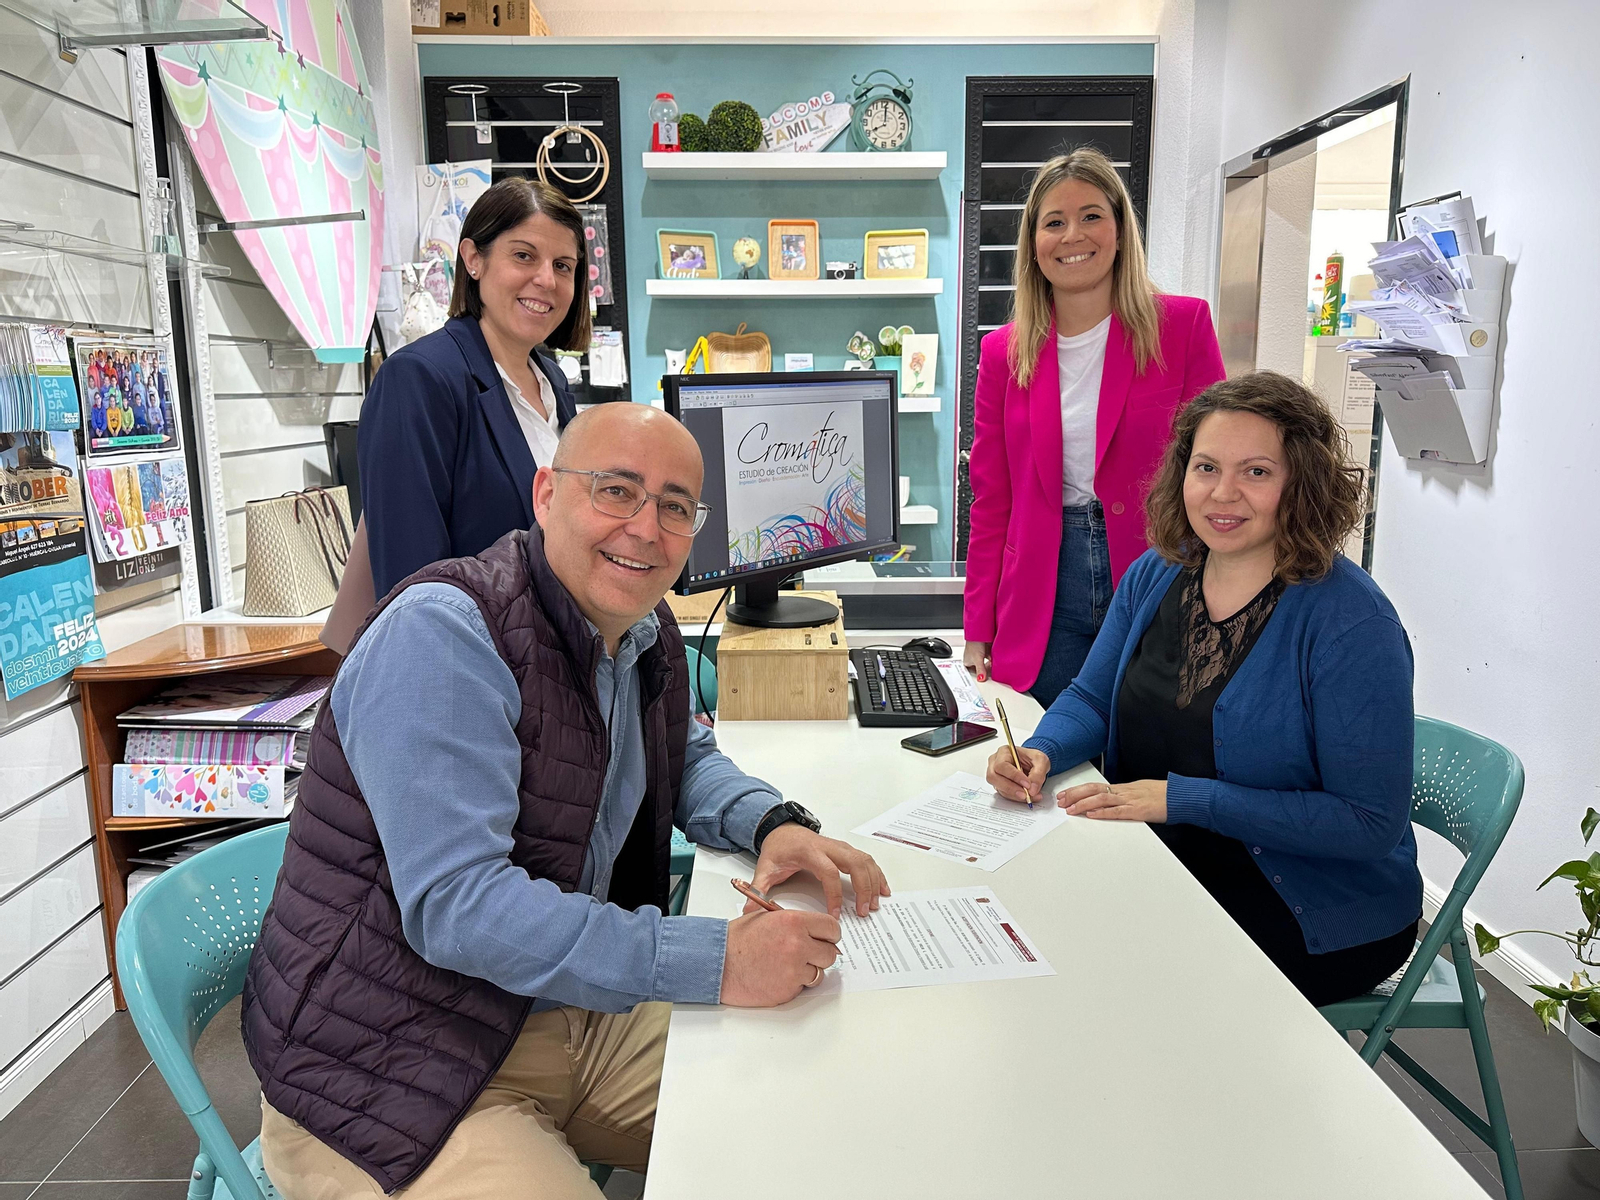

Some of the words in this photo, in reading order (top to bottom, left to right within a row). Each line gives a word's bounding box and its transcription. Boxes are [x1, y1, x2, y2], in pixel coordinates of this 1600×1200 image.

[762, 92, 834, 129] ELCOME
[898, 112, 904, 120] 2
[764, 110, 827, 149] FAMILY
[46, 389, 68, 399] LEN
[48, 400, 64, 410] DA
[738, 411, 854, 484] Cromática
[739, 468, 765, 480] ESTUDIO
[766, 468, 774, 476] de
[776, 463, 809, 475] CREACIÓN
[145, 510, 167, 522] Feliz
[116, 561, 136, 580] LIZ
[138, 553, 163, 565] VEINTI
[0, 574, 93, 630] CALEN
[52, 612, 94, 641] FELIZ
[57, 627, 99, 656] 2024
[5, 645, 58, 679] dosmil
[8, 644, 104, 694] veinticuatro
